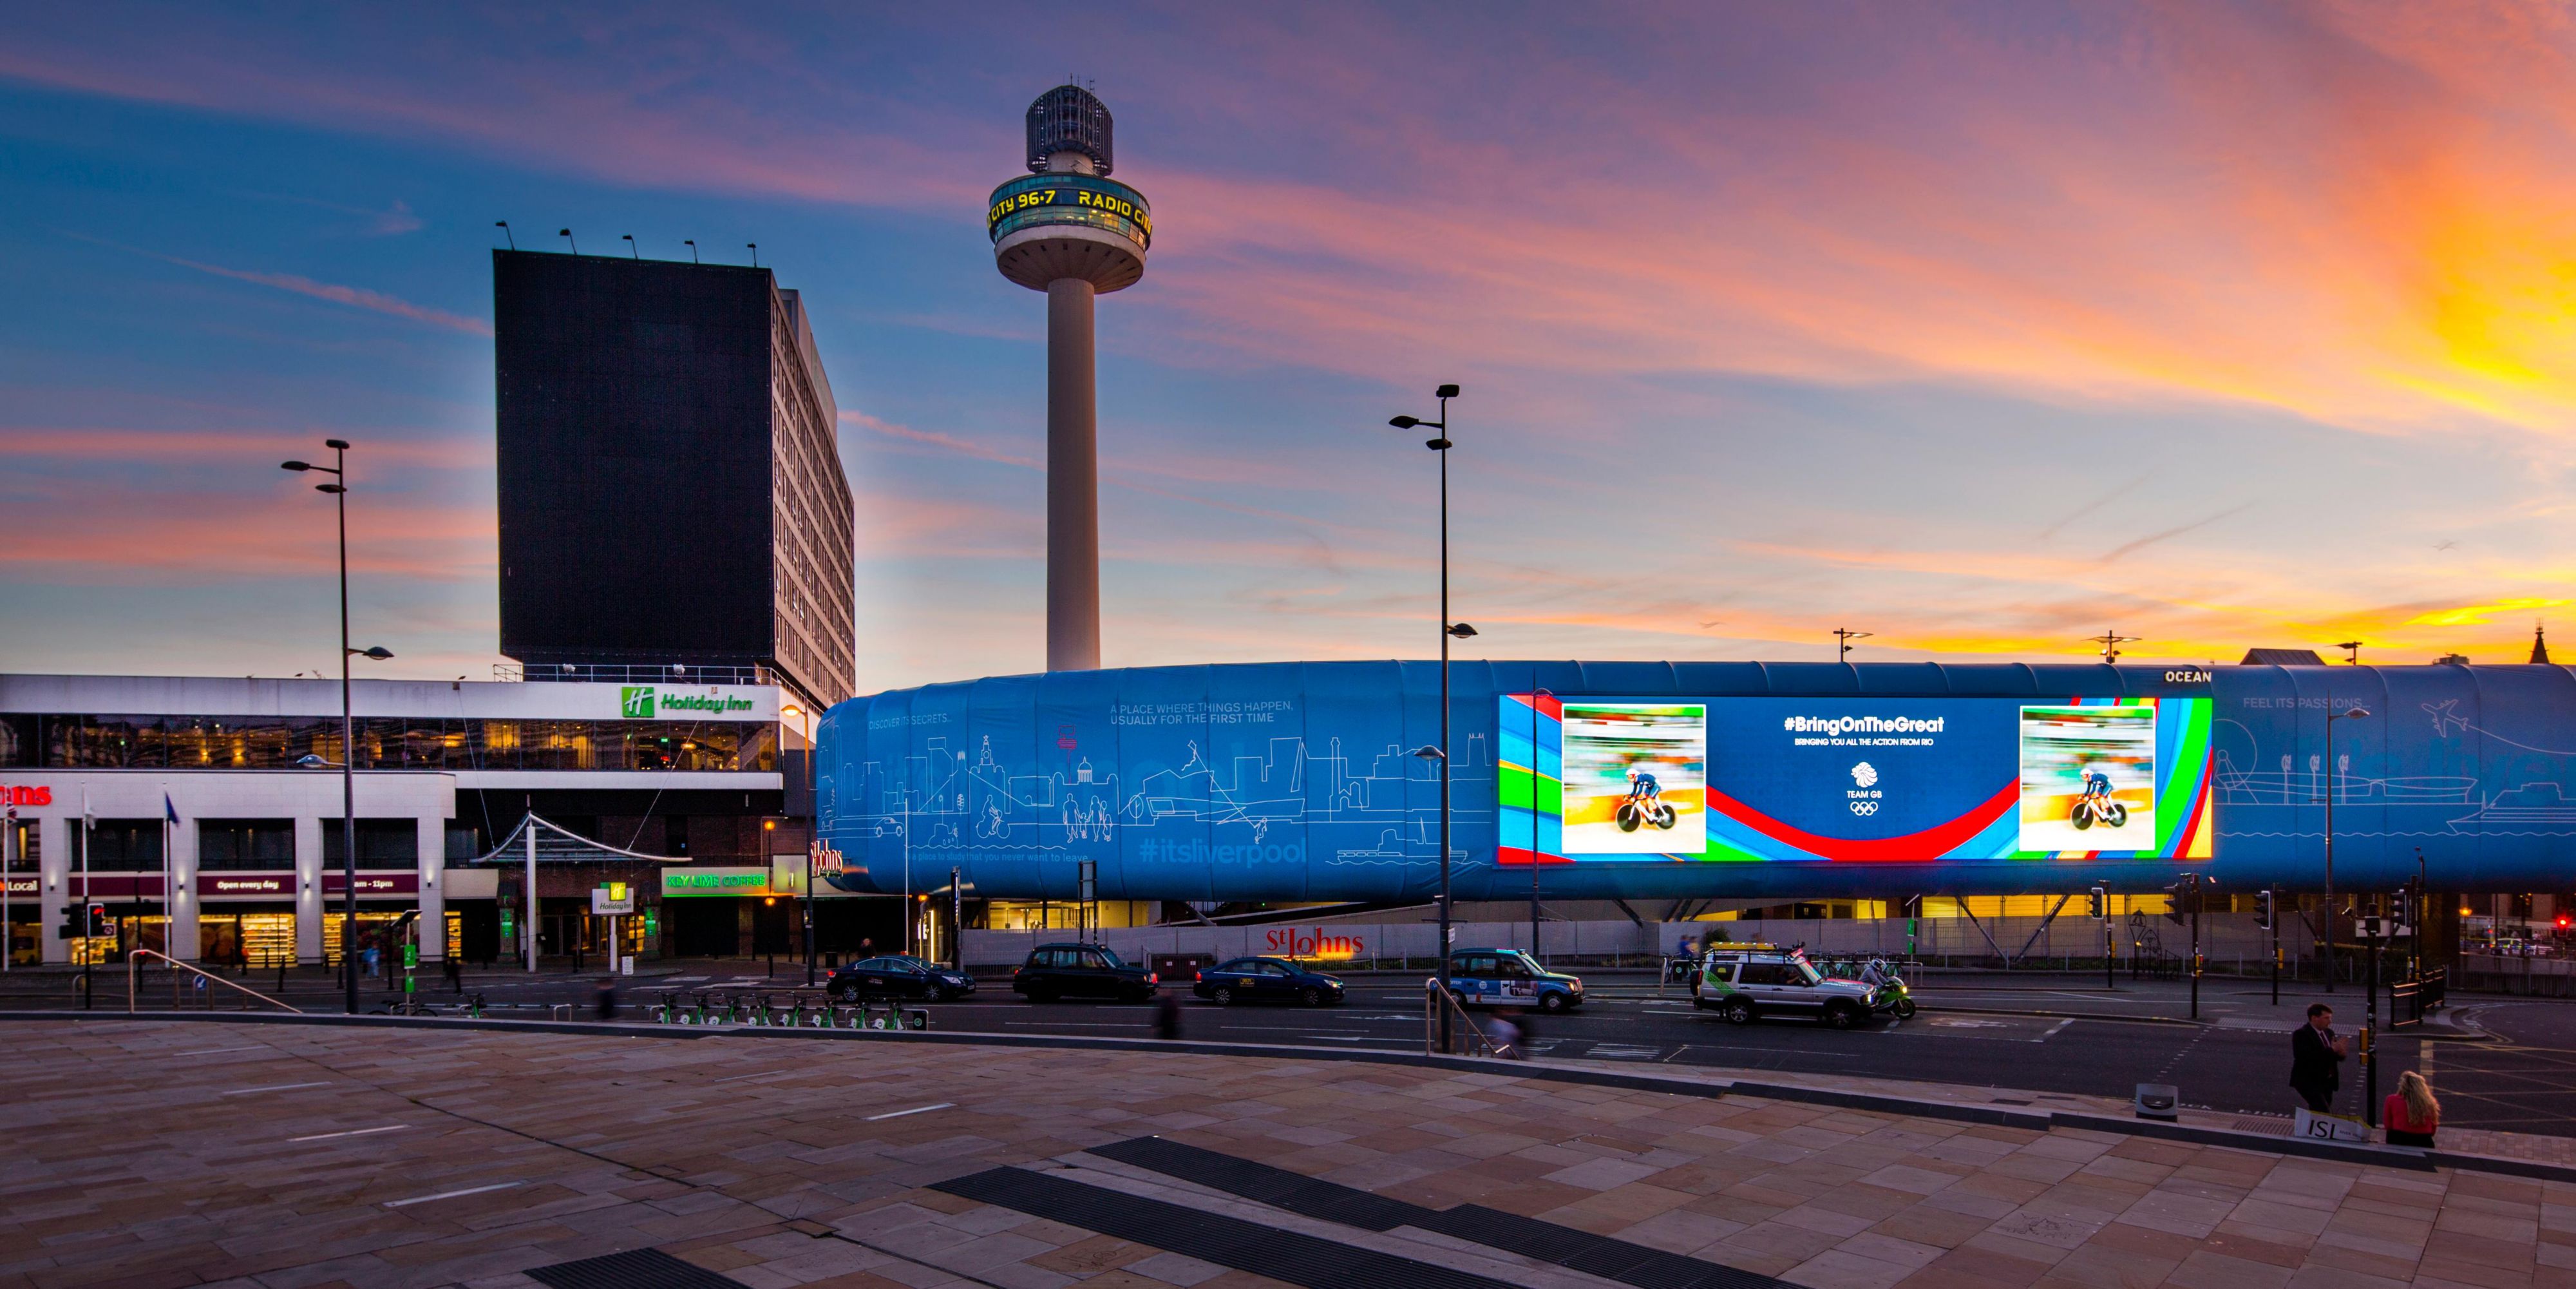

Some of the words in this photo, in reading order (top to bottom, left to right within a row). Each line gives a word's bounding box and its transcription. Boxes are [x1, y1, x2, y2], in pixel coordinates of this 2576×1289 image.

[990, 197, 1014, 222] CITY
[1079, 191, 1131, 216] RADIO
[2165, 671, 2211, 682] OCEAN
[661, 693, 724, 714] Holiday
[726, 694, 752, 711] Inn
[1110, 705, 1117, 714] A
[1120, 704, 1153, 714] PLACE
[1156, 703, 1195, 714] WHERE
[1197, 703, 1240, 712] THINGS
[1244, 701, 1293, 712] HAPPEN,
[2243, 698, 2273, 708] FEEL
[2276, 698, 2295, 708] ITS
[869, 718, 900, 730] DISCOVER
[900, 716, 910, 726] ITS
[1110, 715, 1157, 725] USUALLY
[1160, 714, 1182, 724] FOR
[1185, 714, 1207, 724] THE
[1210, 713, 1242, 723] FIRST
[1246, 712, 1274, 723] TIME
[1784, 716, 1944, 736] #BringOnTheGreat
[0, 786, 52, 805] ns
[918, 852, 936, 862] place
[946, 852, 965, 862] study
[967, 852, 982, 861] that
[985, 854, 999, 862] you
[1051, 853, 1061, 862] to
[1139, 837, 1307, 868] #itsliverpool
[8, 880, 37, 891] Local
[217, 881, 238, 890] Open
[263, 881, 279, 890] day
[372, 880, 393, 889] 11pm
[667, 875, 690, 888] KEY
[692, 874, 719, 888] LIME
[721, 874, 766, 888] COFFEE
[600, 902, 623, 911] Holiday
[1267, 929, 1286, 951] St
[1283, 927, 1364, 959] Johns
